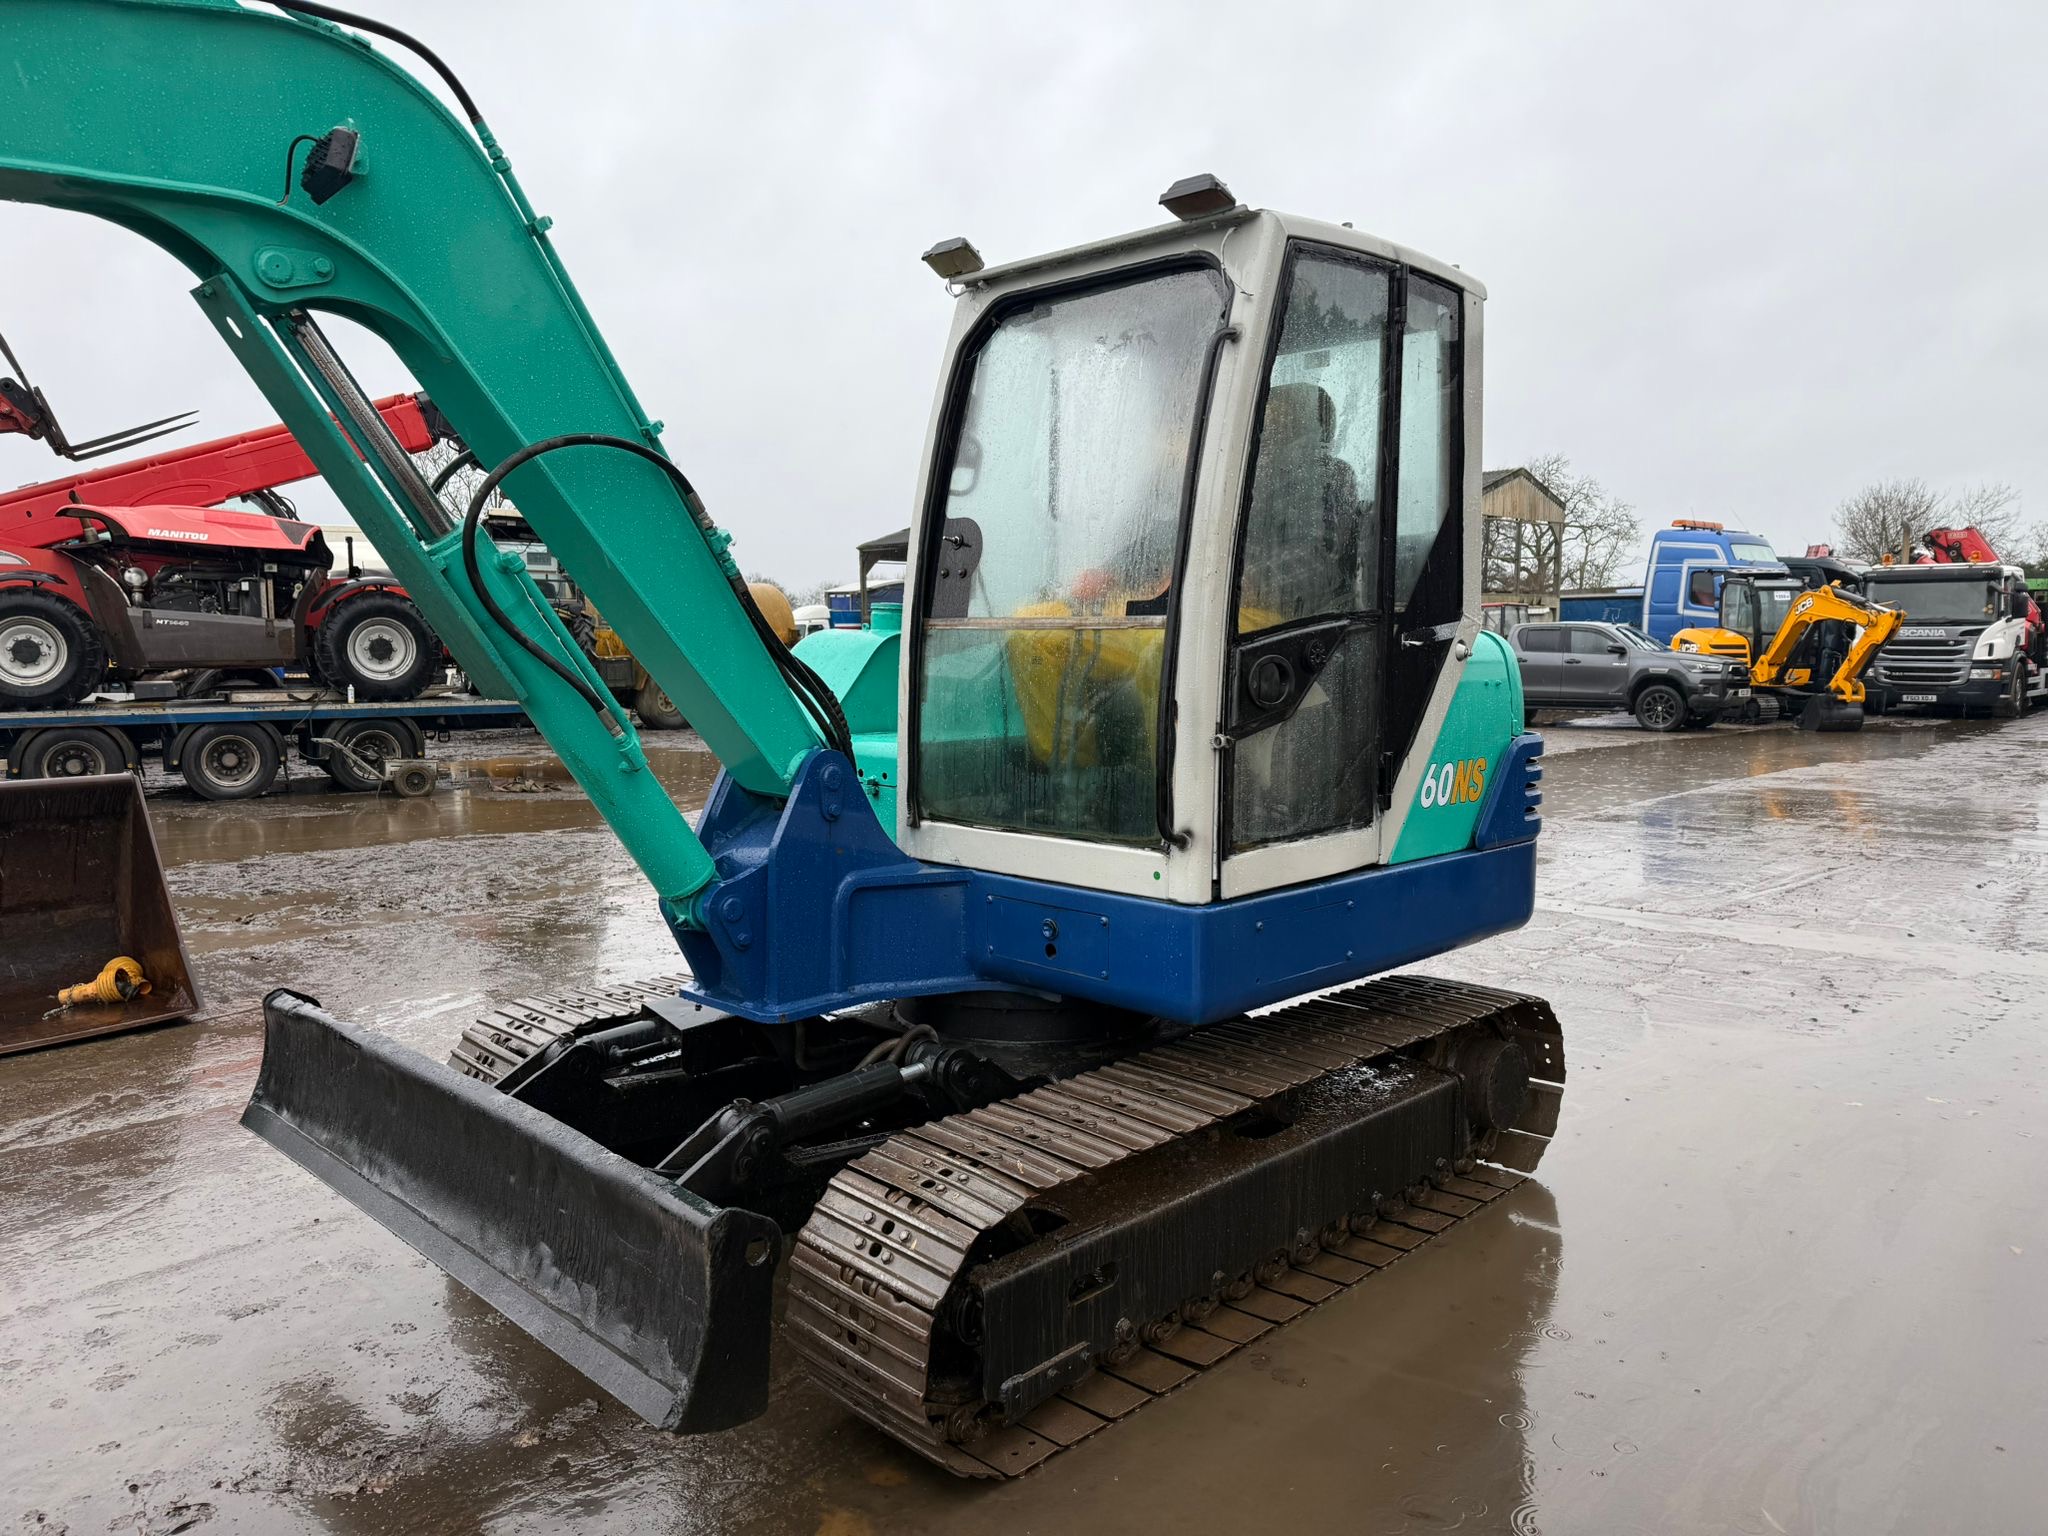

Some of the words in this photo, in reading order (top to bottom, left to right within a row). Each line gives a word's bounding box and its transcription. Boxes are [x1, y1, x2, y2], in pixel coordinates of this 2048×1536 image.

[147, 528, 209, 541] MANITOU
[1795, 597, 1814, 615] JCB
[1900, 629, 1946, 637] SCANIA
[1420, 757, 1487, 809] 60NS
